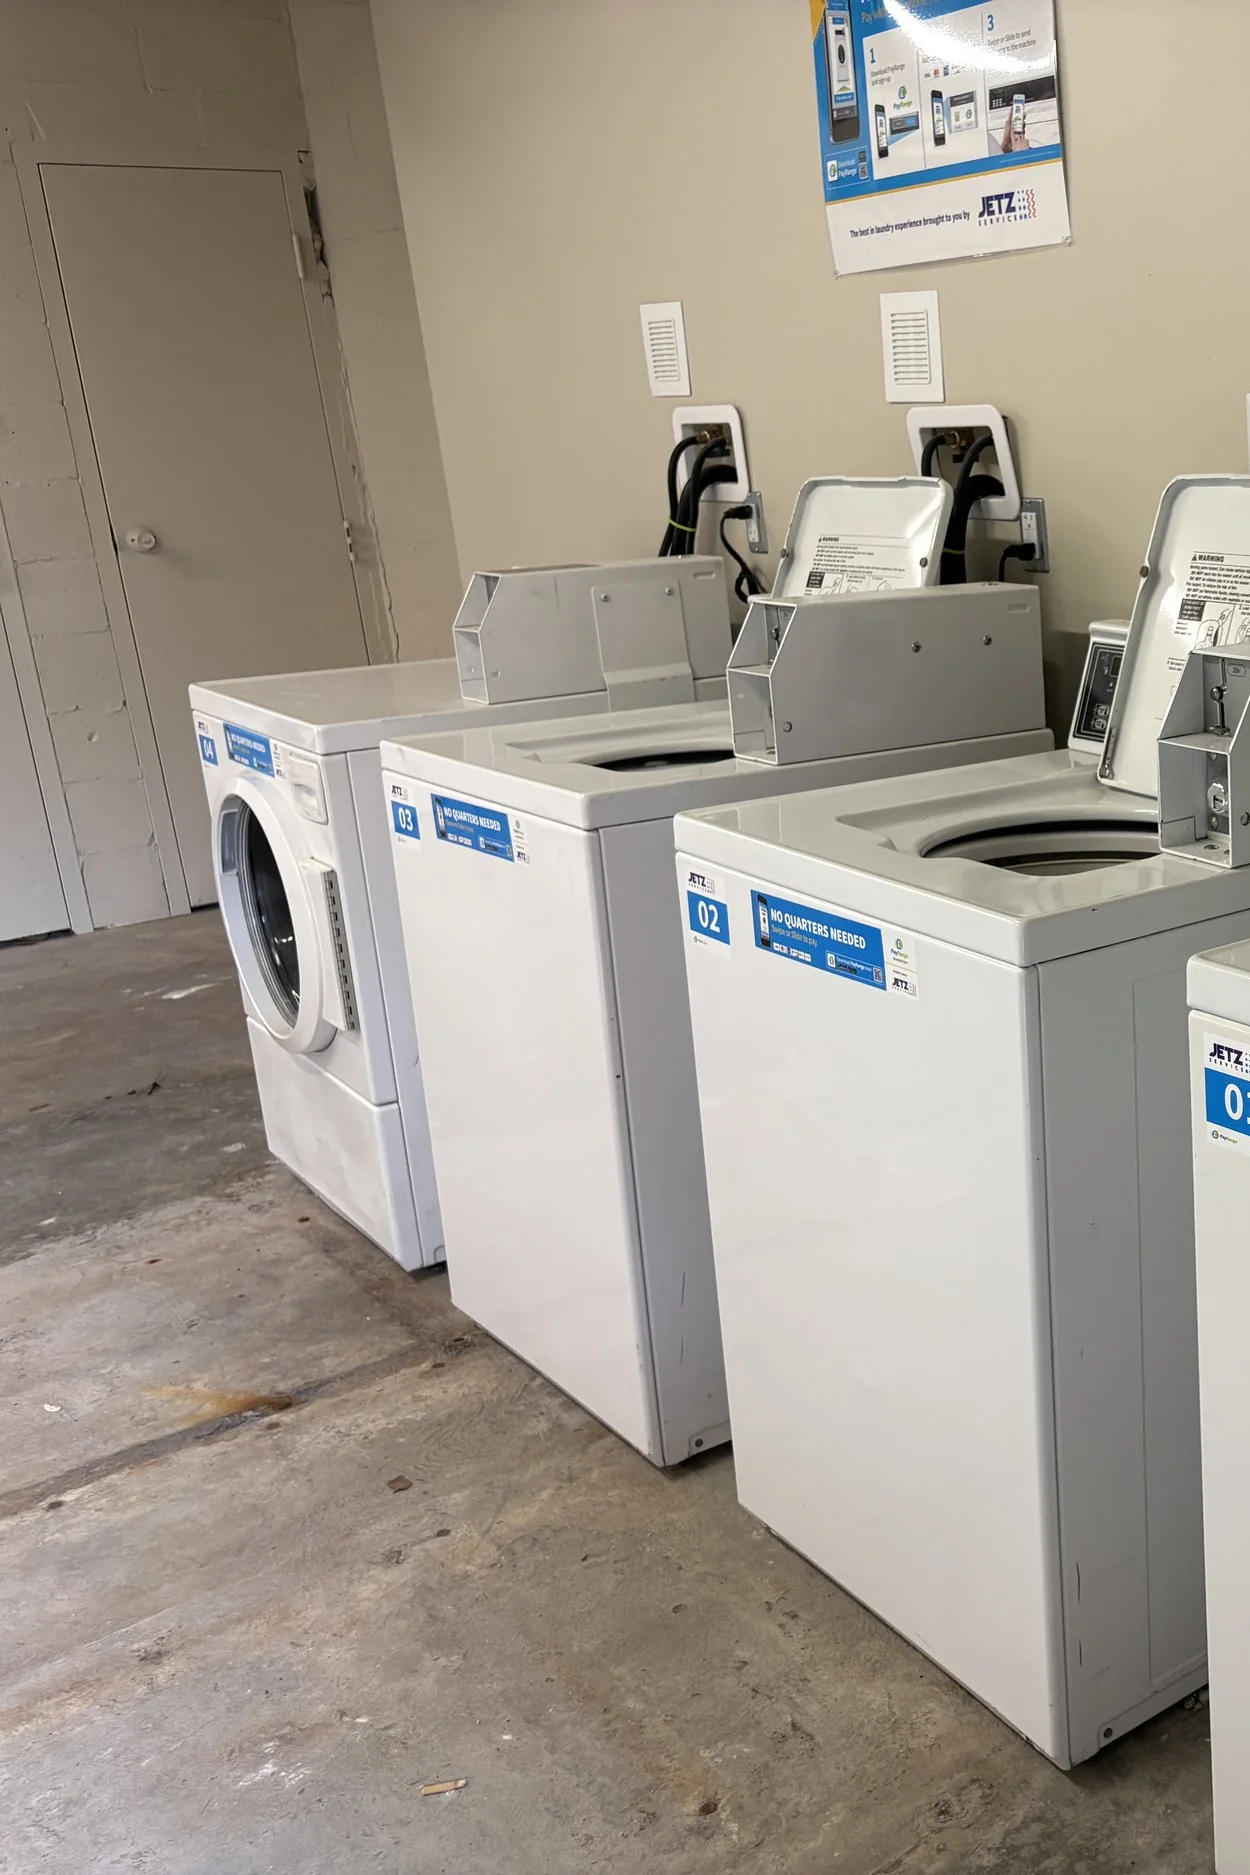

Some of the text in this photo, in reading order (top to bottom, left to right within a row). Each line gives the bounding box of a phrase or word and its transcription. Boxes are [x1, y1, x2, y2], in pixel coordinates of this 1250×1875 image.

[988, 15, 994, 31] 3
[870, 48, 876, 64] 1
[978, 191, 1016, 218] JETZ
[850, 230, 858, 238] The
[859, 228, 869, 237] best
[870, 227, 875, 235] in
[875, 224, 894, 234] laundry
[895, 219, 922, 231] experience
[923, 214, 945, 226] brought
[952, 212, 963, 221] you
[963, 210, 971, 220] by
[978, 215, 1018, 227] SERVICE
[398, 807, 413, 831] 03
[444, 806, 452, 818] NO
[453, 809, 479, 825] QUARTERS
[479, 816, 501, 832] NEEDED
[688, 872, 706, 887] JETZ
[698, 900, 720, 933] 02
[771, 908, 866, 949] NO QUARTERS NEEDED
[892, 977, 908, 990] JETZ
[1209, 1043, 1243, 1066] JETZ
[1209, 1057, 1244, 1072] SERVICE
